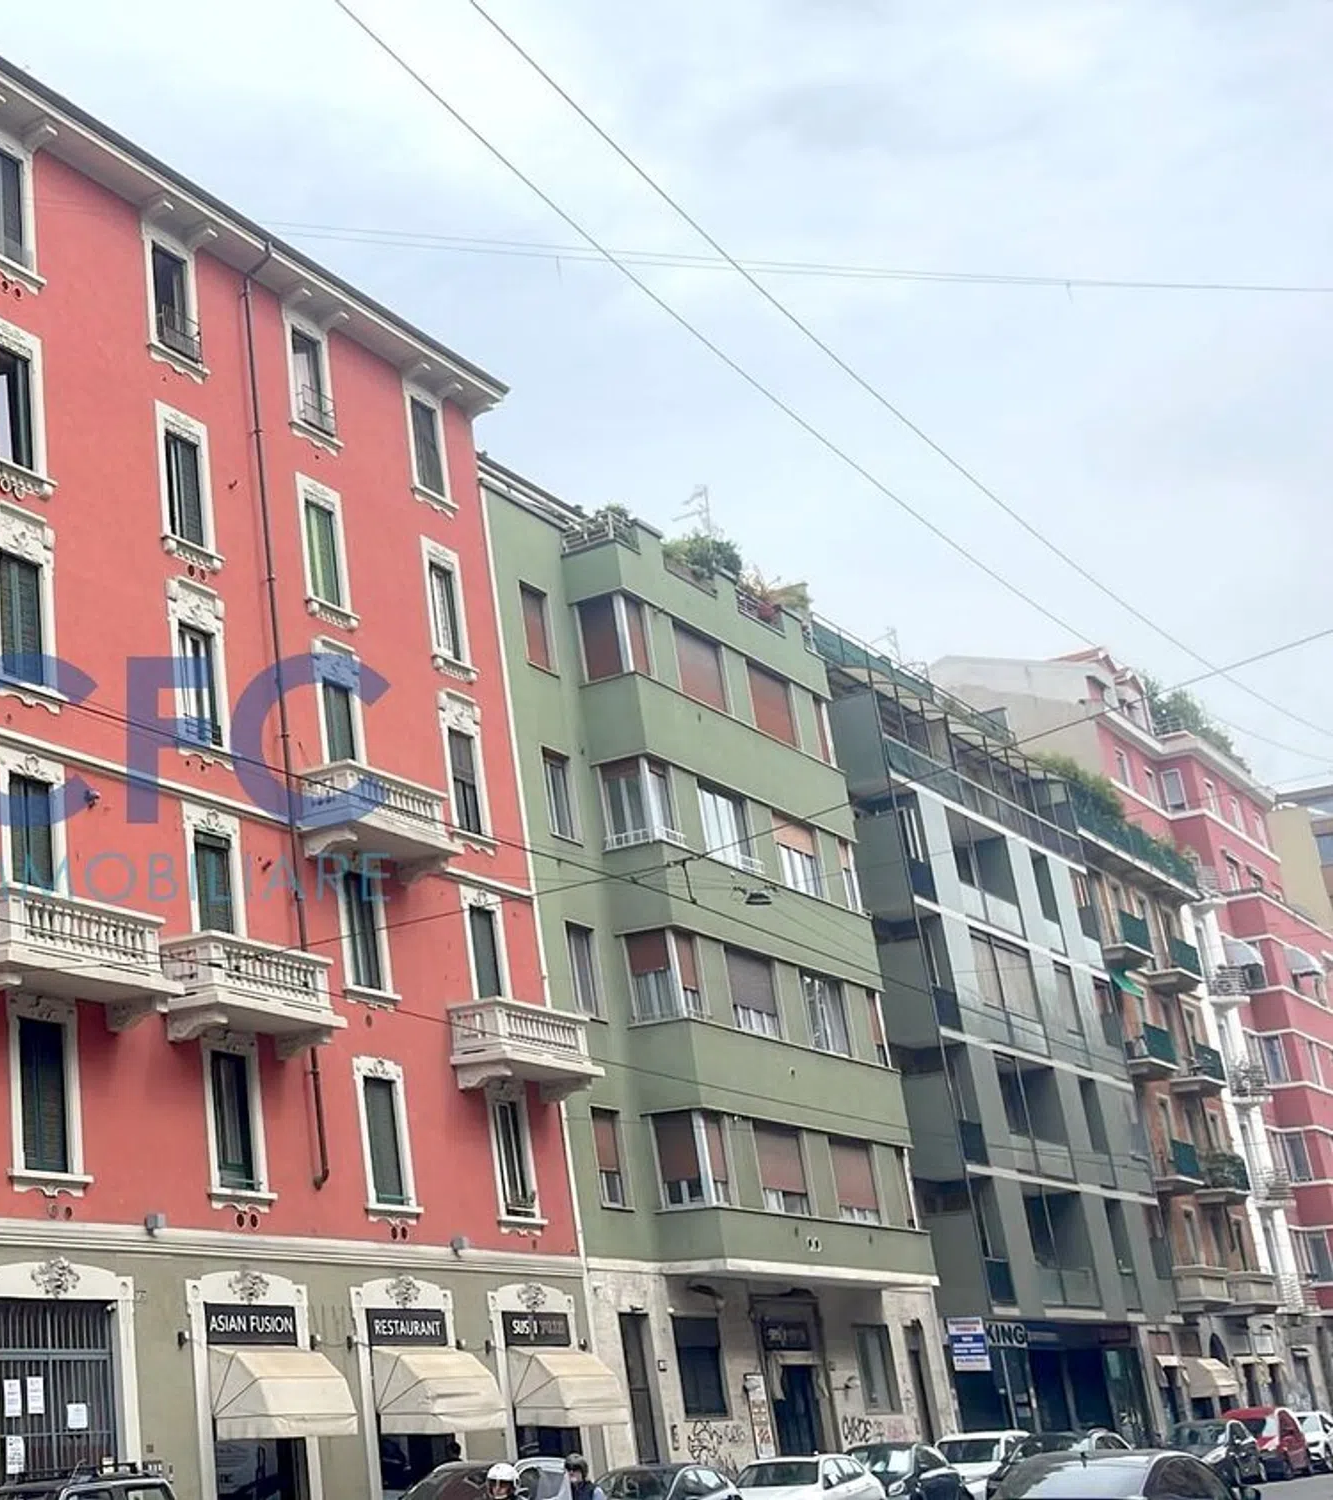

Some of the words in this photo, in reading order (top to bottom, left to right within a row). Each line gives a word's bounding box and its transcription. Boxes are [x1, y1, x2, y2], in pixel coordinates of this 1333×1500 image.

[209, 1315, 247, 1332] ASIAN
[250, 1315, 294, 1333] FUSION
[374, 1318, 442, 1336] RESTAURANT
